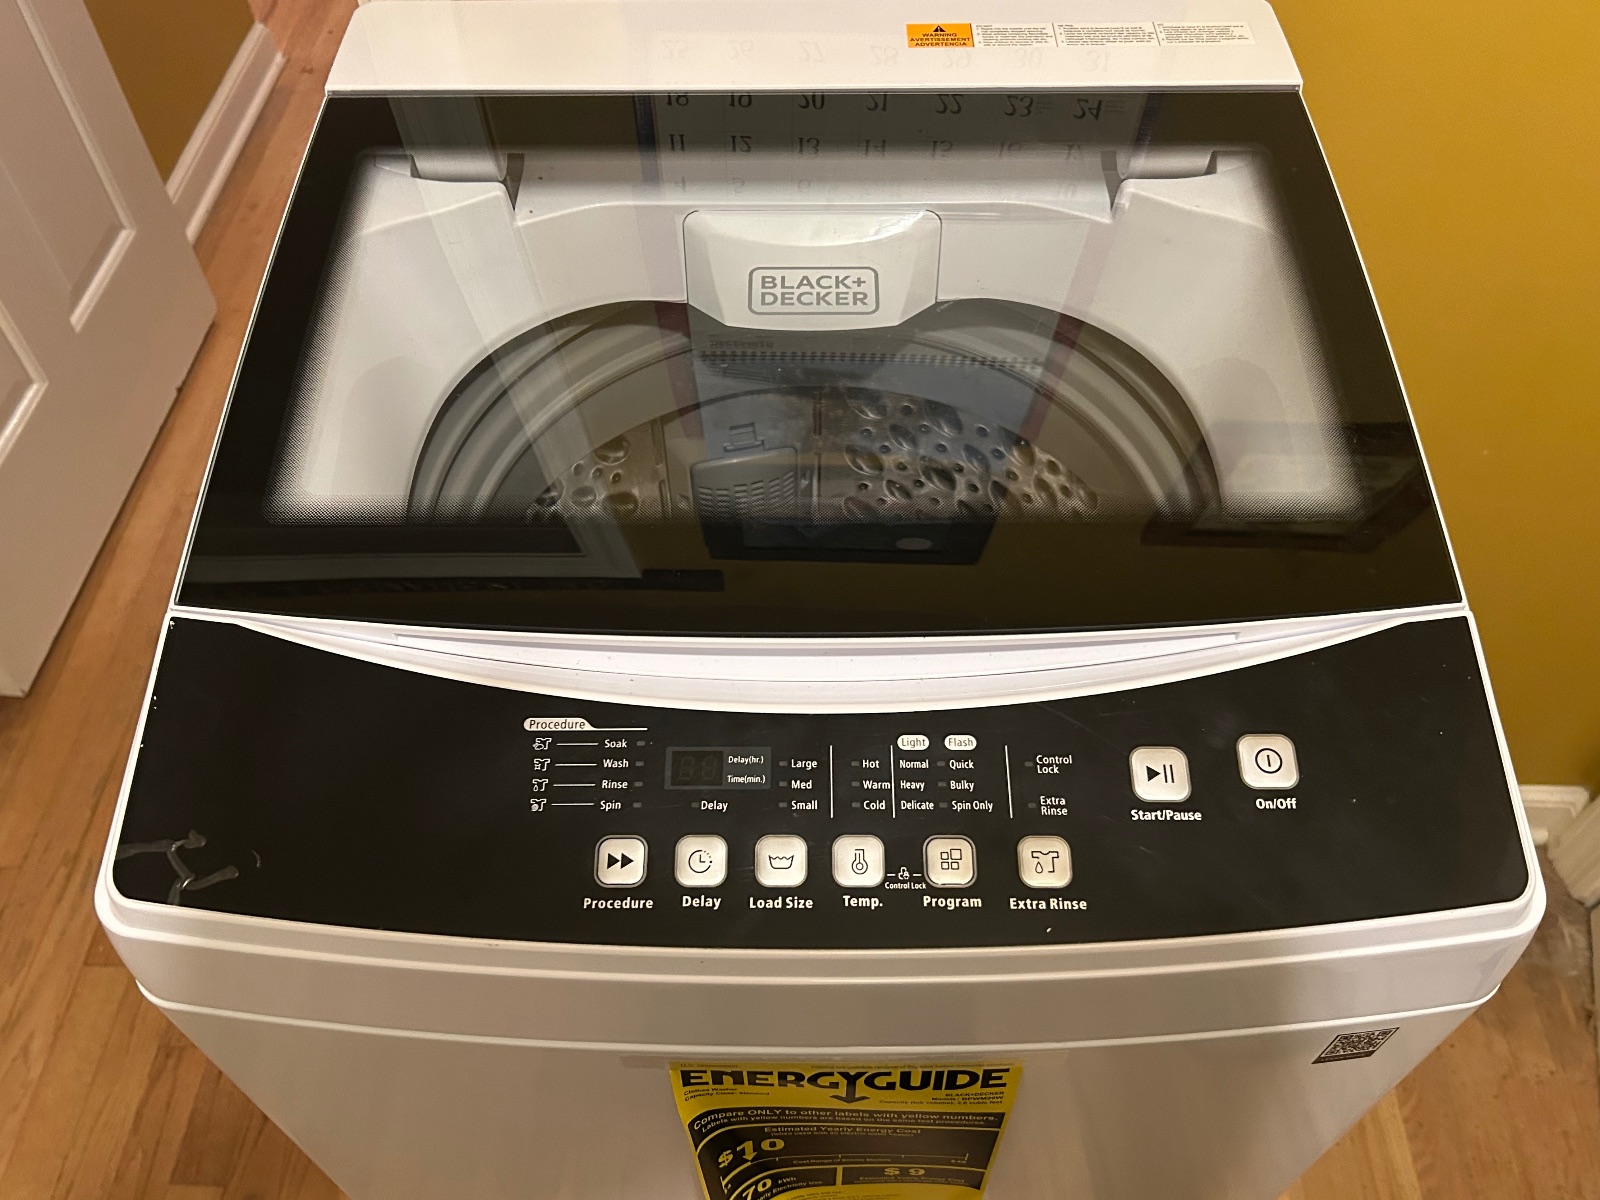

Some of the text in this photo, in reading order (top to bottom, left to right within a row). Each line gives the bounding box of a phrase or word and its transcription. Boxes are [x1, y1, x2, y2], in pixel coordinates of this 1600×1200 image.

[761, 275, 866, 289] BLACK+
[760, 291, 868, 306] DECKER
[529, 719, 586, 730] Procedure
[604, 739, 628, 748] Soak
[901, 738, 926, 748] Light
[948, 738, 974, 747] Flash
[602, 759, 629, 768] Wash
[728, 755, 764, 765] Delay(hr.)
[791, 759, 818, 770] Large
[862, 759, 880, 769] Hot
[899, 759, 929, 769] Normal
[949, 759, 975, 770] Quick
[1036, 755, 1073, 765] Control
[1036, 765, 1060, 774] Lock
[601, 780, 629, 789] Rinse
[727, 775, 766, 784] Time(min.)
[791, 780, 812, 789] Med
[862, 780, 891, 790] Warm
[900, 780, 925, 791] Heavy
[950, 780, 975, 792] Bulky
[600, 800, 622, 811] Spin
[700, 800, 729, 812] Delay
[791, 800, 818, 810] Small
[863, 800, 886, 810] Cold
[900, 800, 935, 810] Delicate
[951, 801, 994, 812] Spin Only
[1040, 796, 1066, 806] Extra
[1255, 798, 1297, 810] On/Off
[1041, 806, 1068, 816] Rinse
[1130, 809, 1202, 821] Start/Pause
[884, 882, 927, 890] Control Lock
[583, 896, 654, 909] Procedure
[682, 895, 722, 910] Delay
[749, 896, 814, 909] Load Size
[843, 895, 884, 910] Temp.
[923, 895, 983, 911] Program
[1009, 897, 1087, 910] Extra Rinse
[693, 1110, 744, 1130] Compare
[701, 1118, 728, 1133] Labels
